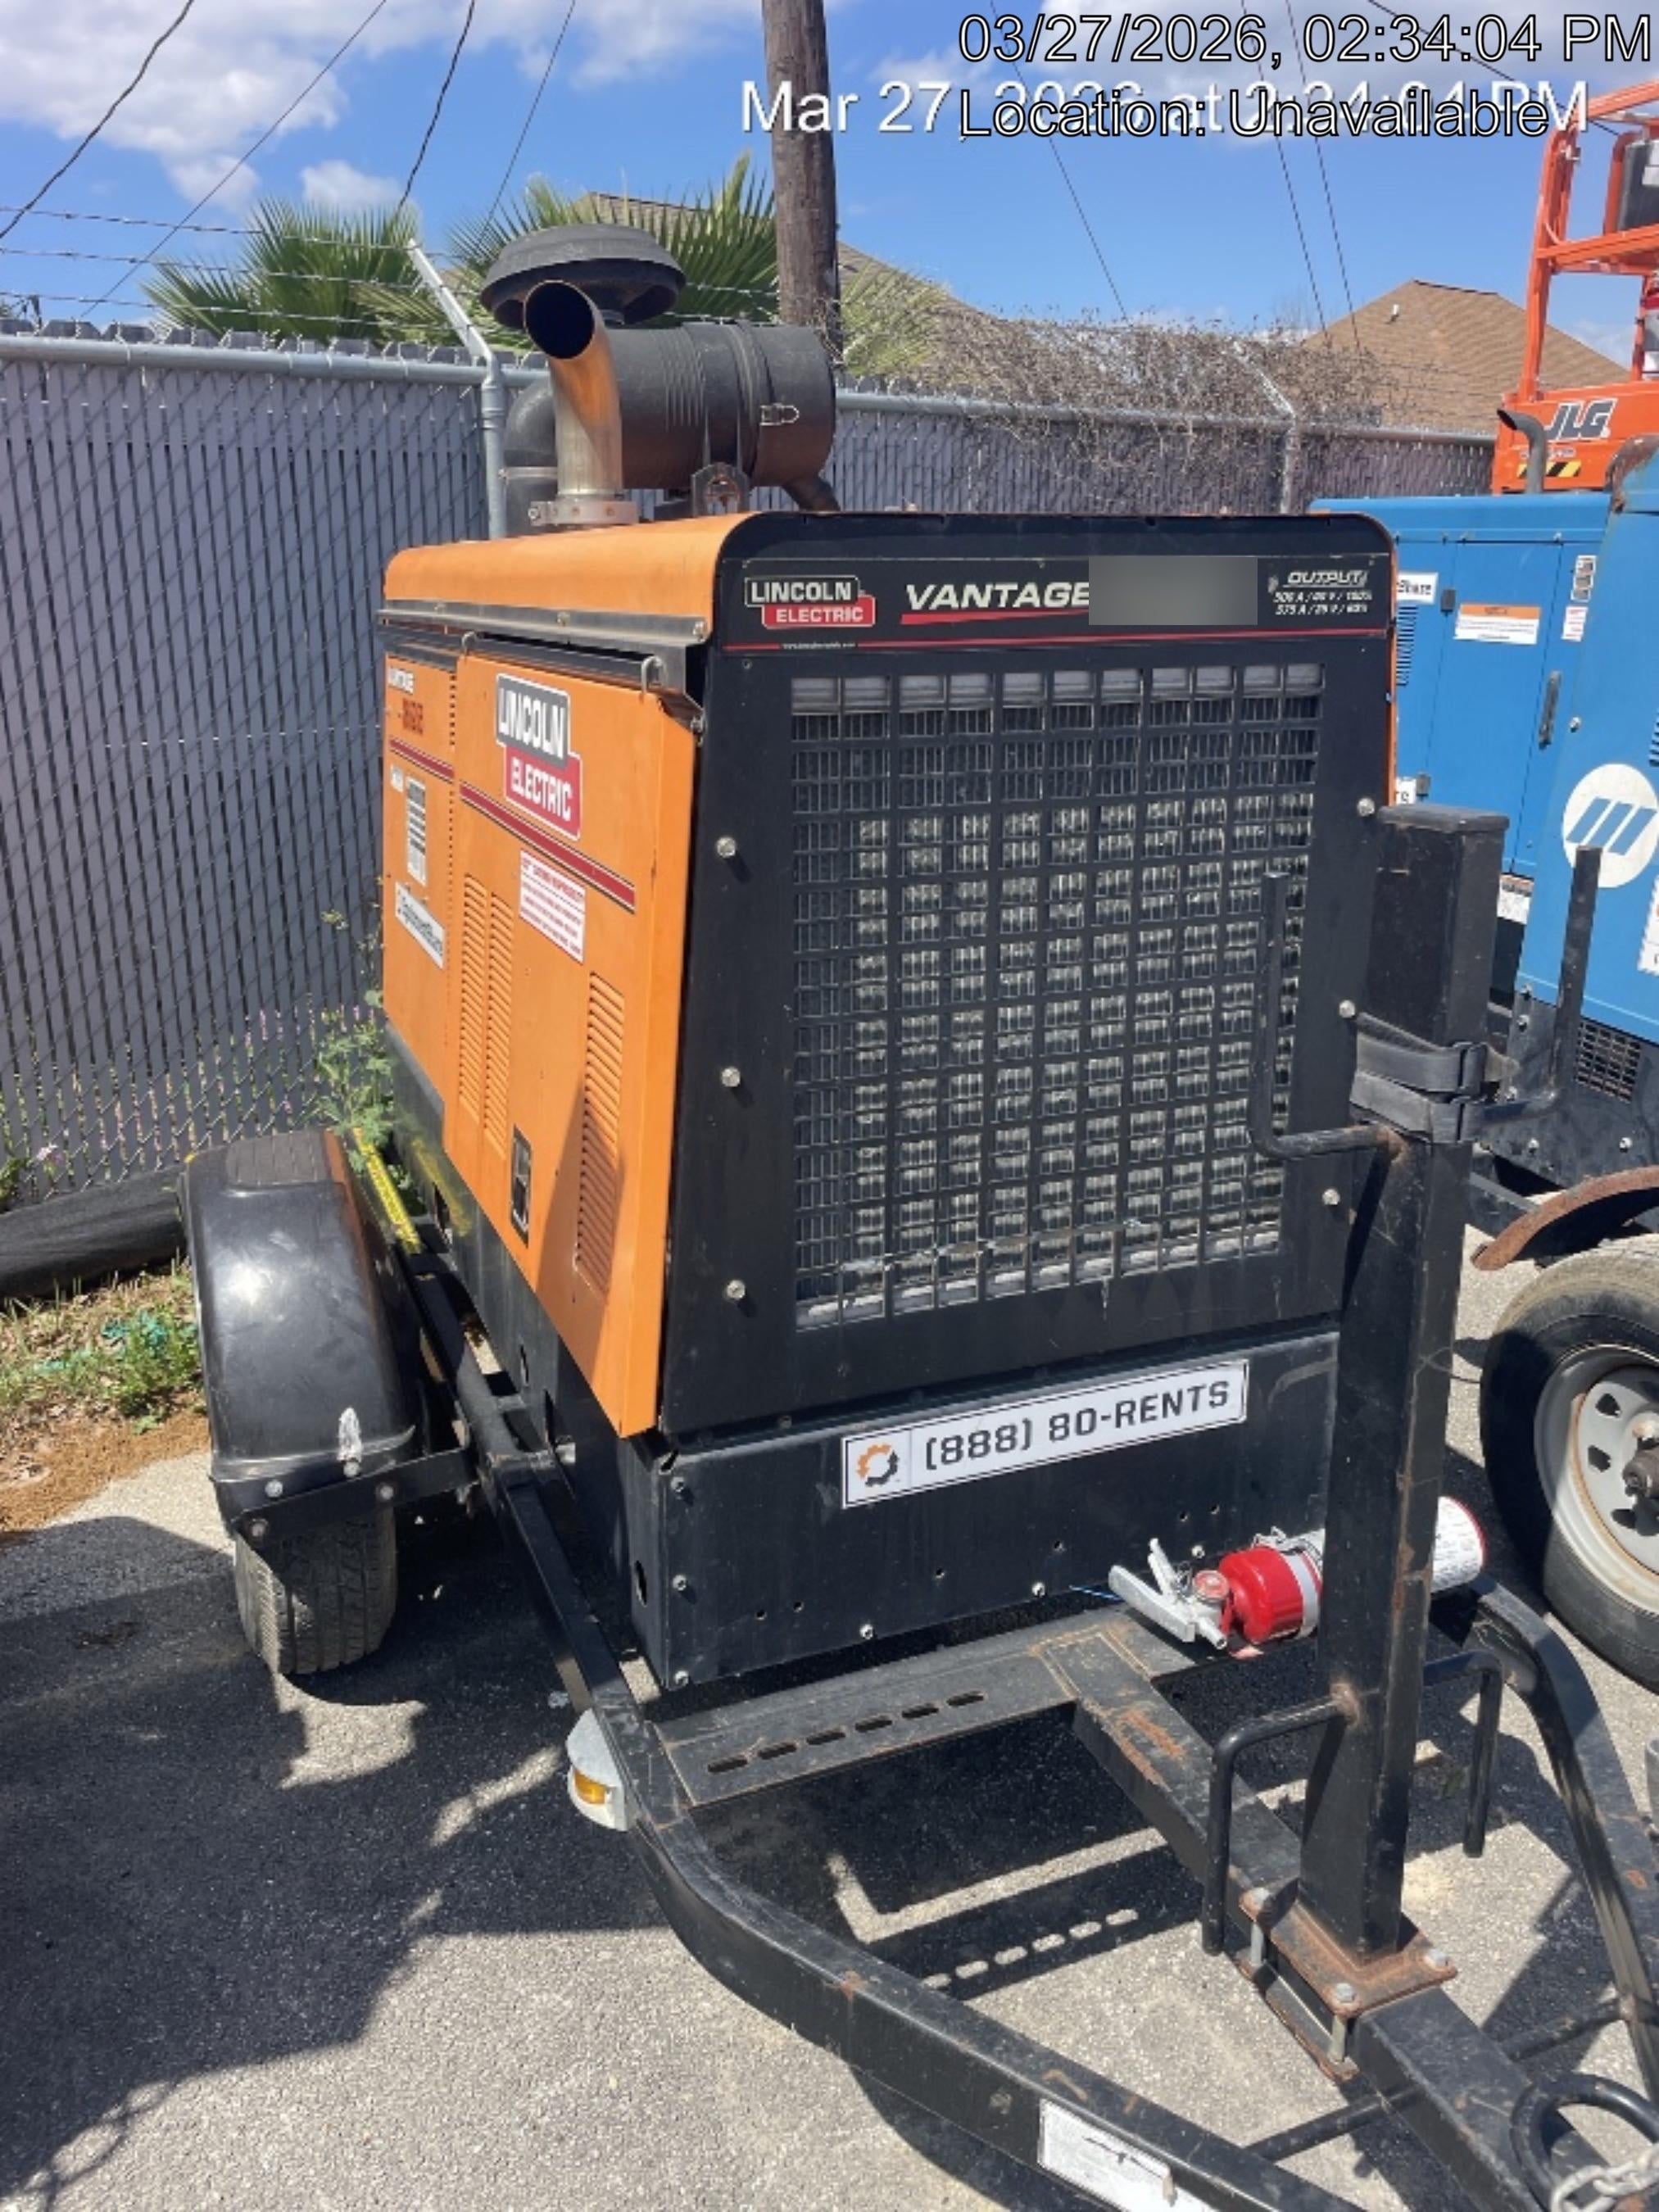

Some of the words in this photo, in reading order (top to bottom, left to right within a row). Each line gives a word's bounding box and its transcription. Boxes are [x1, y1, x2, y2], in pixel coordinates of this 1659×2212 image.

[1545, 397, 1617, 442] JLG
[750, 582, 852, 603] LINCOLN
[1288, 570, 1366, 584] OUTPUT
[906, 582, 1090, 610] VANTAGE
[776, 607, 863, 623] ELECTRIC
[498, 687, 564, 758] LINCOLN
[511, 756, 572, 821] ELECTRIC
[926, 1417, 1033, 1471] (888)
[1049, 1380, 1230, 1442] 80-RENTS
